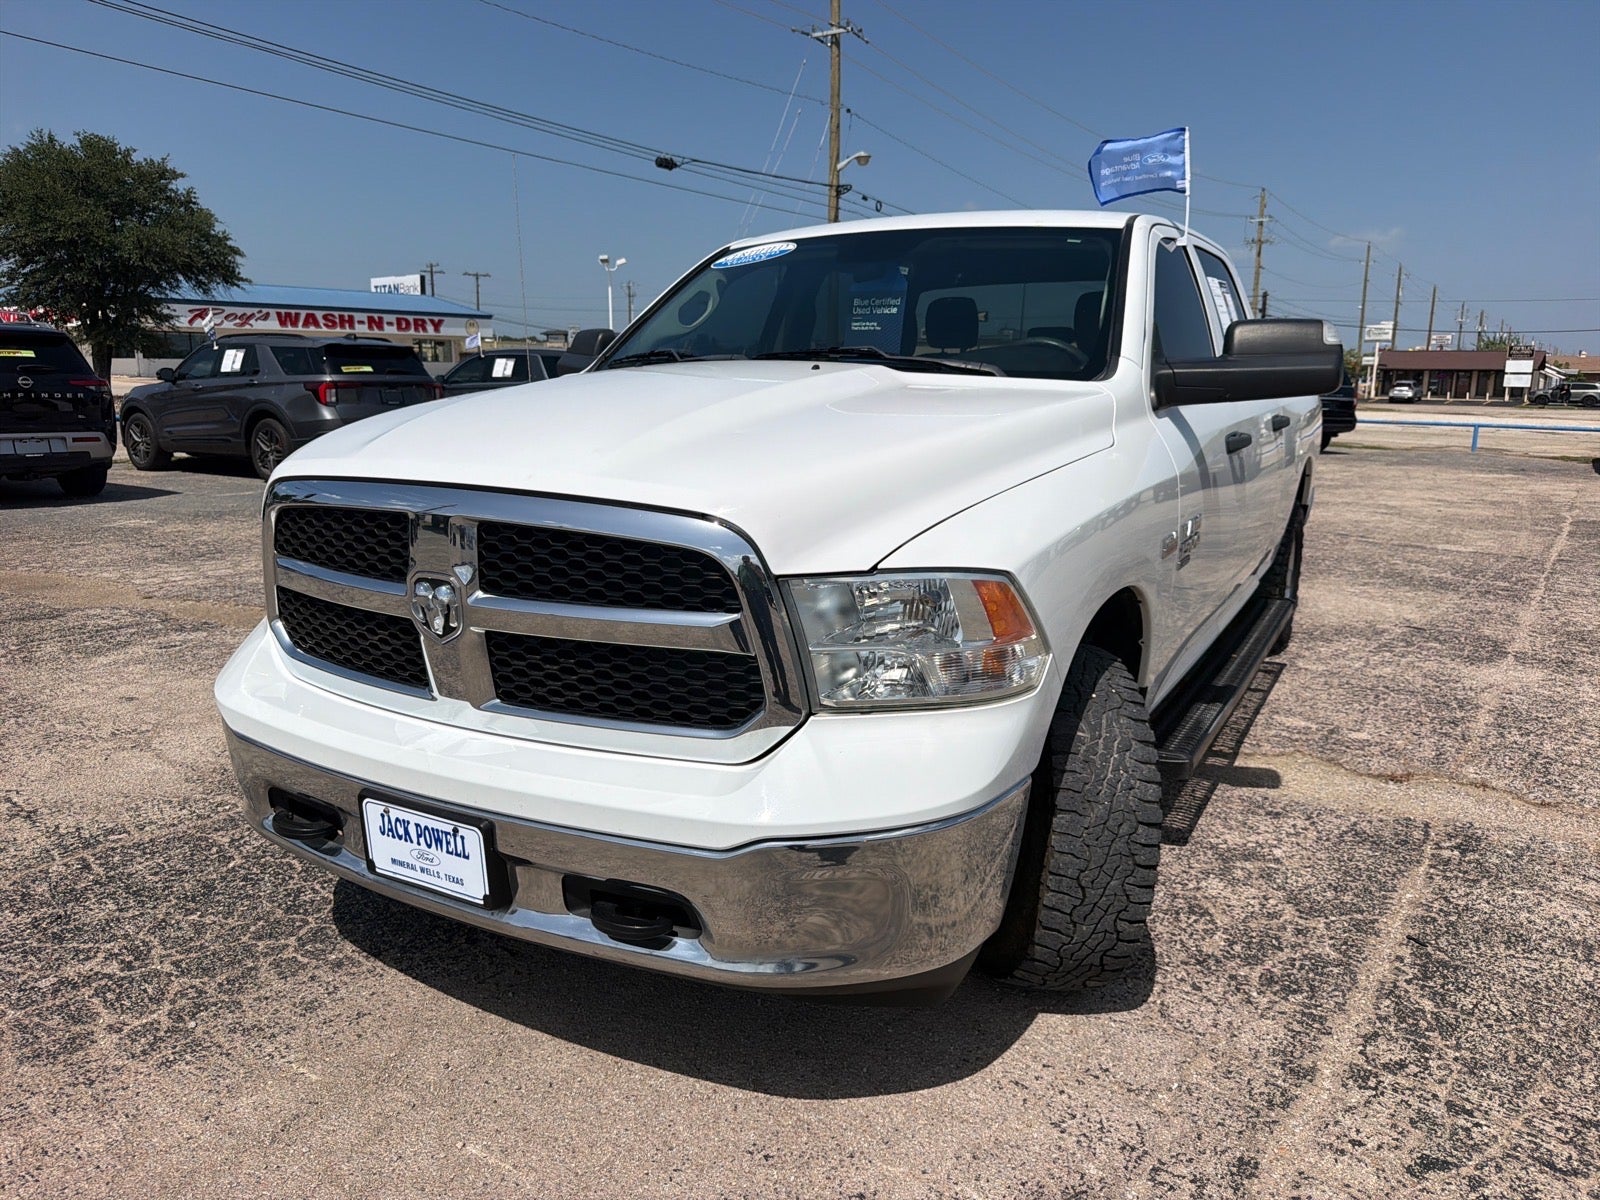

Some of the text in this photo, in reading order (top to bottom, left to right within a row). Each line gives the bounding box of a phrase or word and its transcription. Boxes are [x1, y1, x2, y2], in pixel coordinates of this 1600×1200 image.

[852, 305, 898, 315] Used Vehicle
[853, 297, 901, 306] Blue Certified
[187, 307, 445, 334] Roy's WASH-N-DRY
[379, 813, 469, 860] JACK POWELL
[415, 850, 435, 864] Ford
[391, 858, 464, 886] MINERAL WELLS, TEXAS
